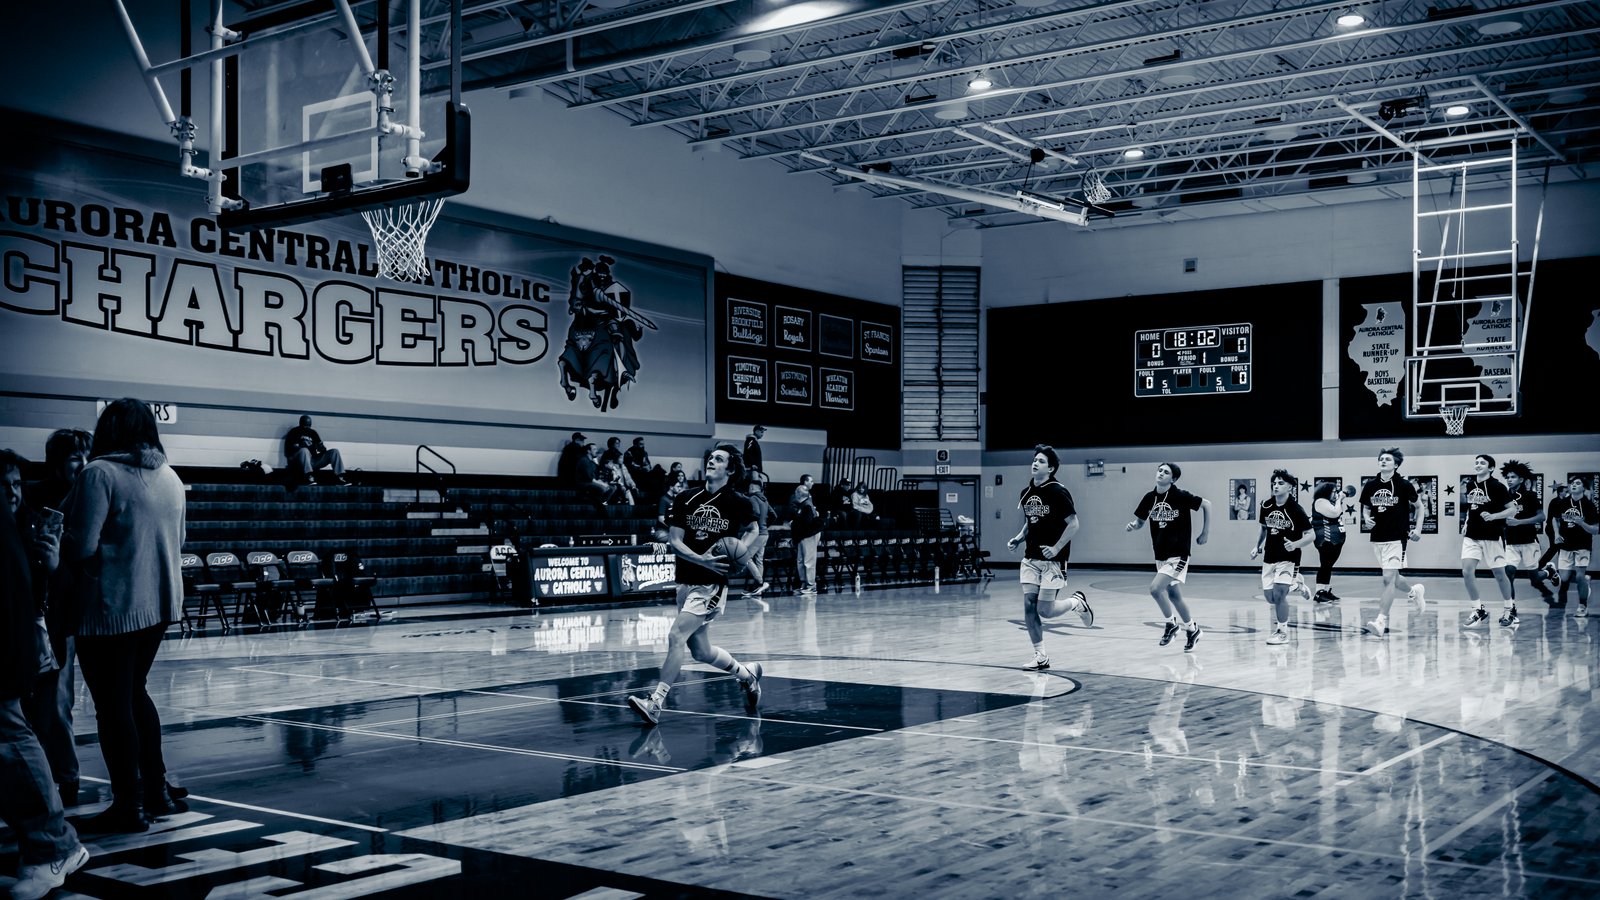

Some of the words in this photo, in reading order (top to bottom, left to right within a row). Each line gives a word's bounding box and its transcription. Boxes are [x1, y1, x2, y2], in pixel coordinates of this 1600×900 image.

[0, 195, 177, 247] URORA
[190, 217, 379, 278] CENTRAL
[0, 230, 549, 367] CHARGERS
[734, 306, 762, 319] RIVERSIDE
[732, 316, 764, 329] BROOKFIELD
[783, 315, 804, 327] ROSARY
[732, 326, 762, 344] Bulldogs
[784, 329, 804, 344] Royals
[1140, 333, 1160, 341] HOME
[1174, 330, 1216, 347] 18:02
[1221, 326, 1250, 336] VISITOR
[1152, 343, 1161, 358] 0
[1238, 337, 1246, 353] 0
[1203, 352, 1206, 364] 1
[735, 362, 760, 374] TIMOTHY
[733, 373, 763, 385] CHRISTIAN
[1146, 376, 1154, 389] 0
[1239, 372, 1247, 384] 0
[1368, 377, 1396, 385] BASKETBALL
[734, 382, 762, 399] Trojans
[826, 384, 848, 392] ACADEMY
[825, 392, 849, 404] Warriors
[212, 555, 234, 565] ACC
[252, 554, 273, 564] ACC
[292, 554, 312, 562] ACC
[335, 554, 347, 562] AC
[548, 557, 580, 567] WELCOME
[581, 557, 589, 566] TO
[638, 555, 655, 563] HOME
[656, 554, 664, 563] OF
[665, 554, 676, 562] THE
[534, 567, 569, 581] AURORA
[570, 565, 605, 580] CENTRAL
[636, 564, 676, 581] CHARGER
[553, 580, 592, 594] CATHOLIC
